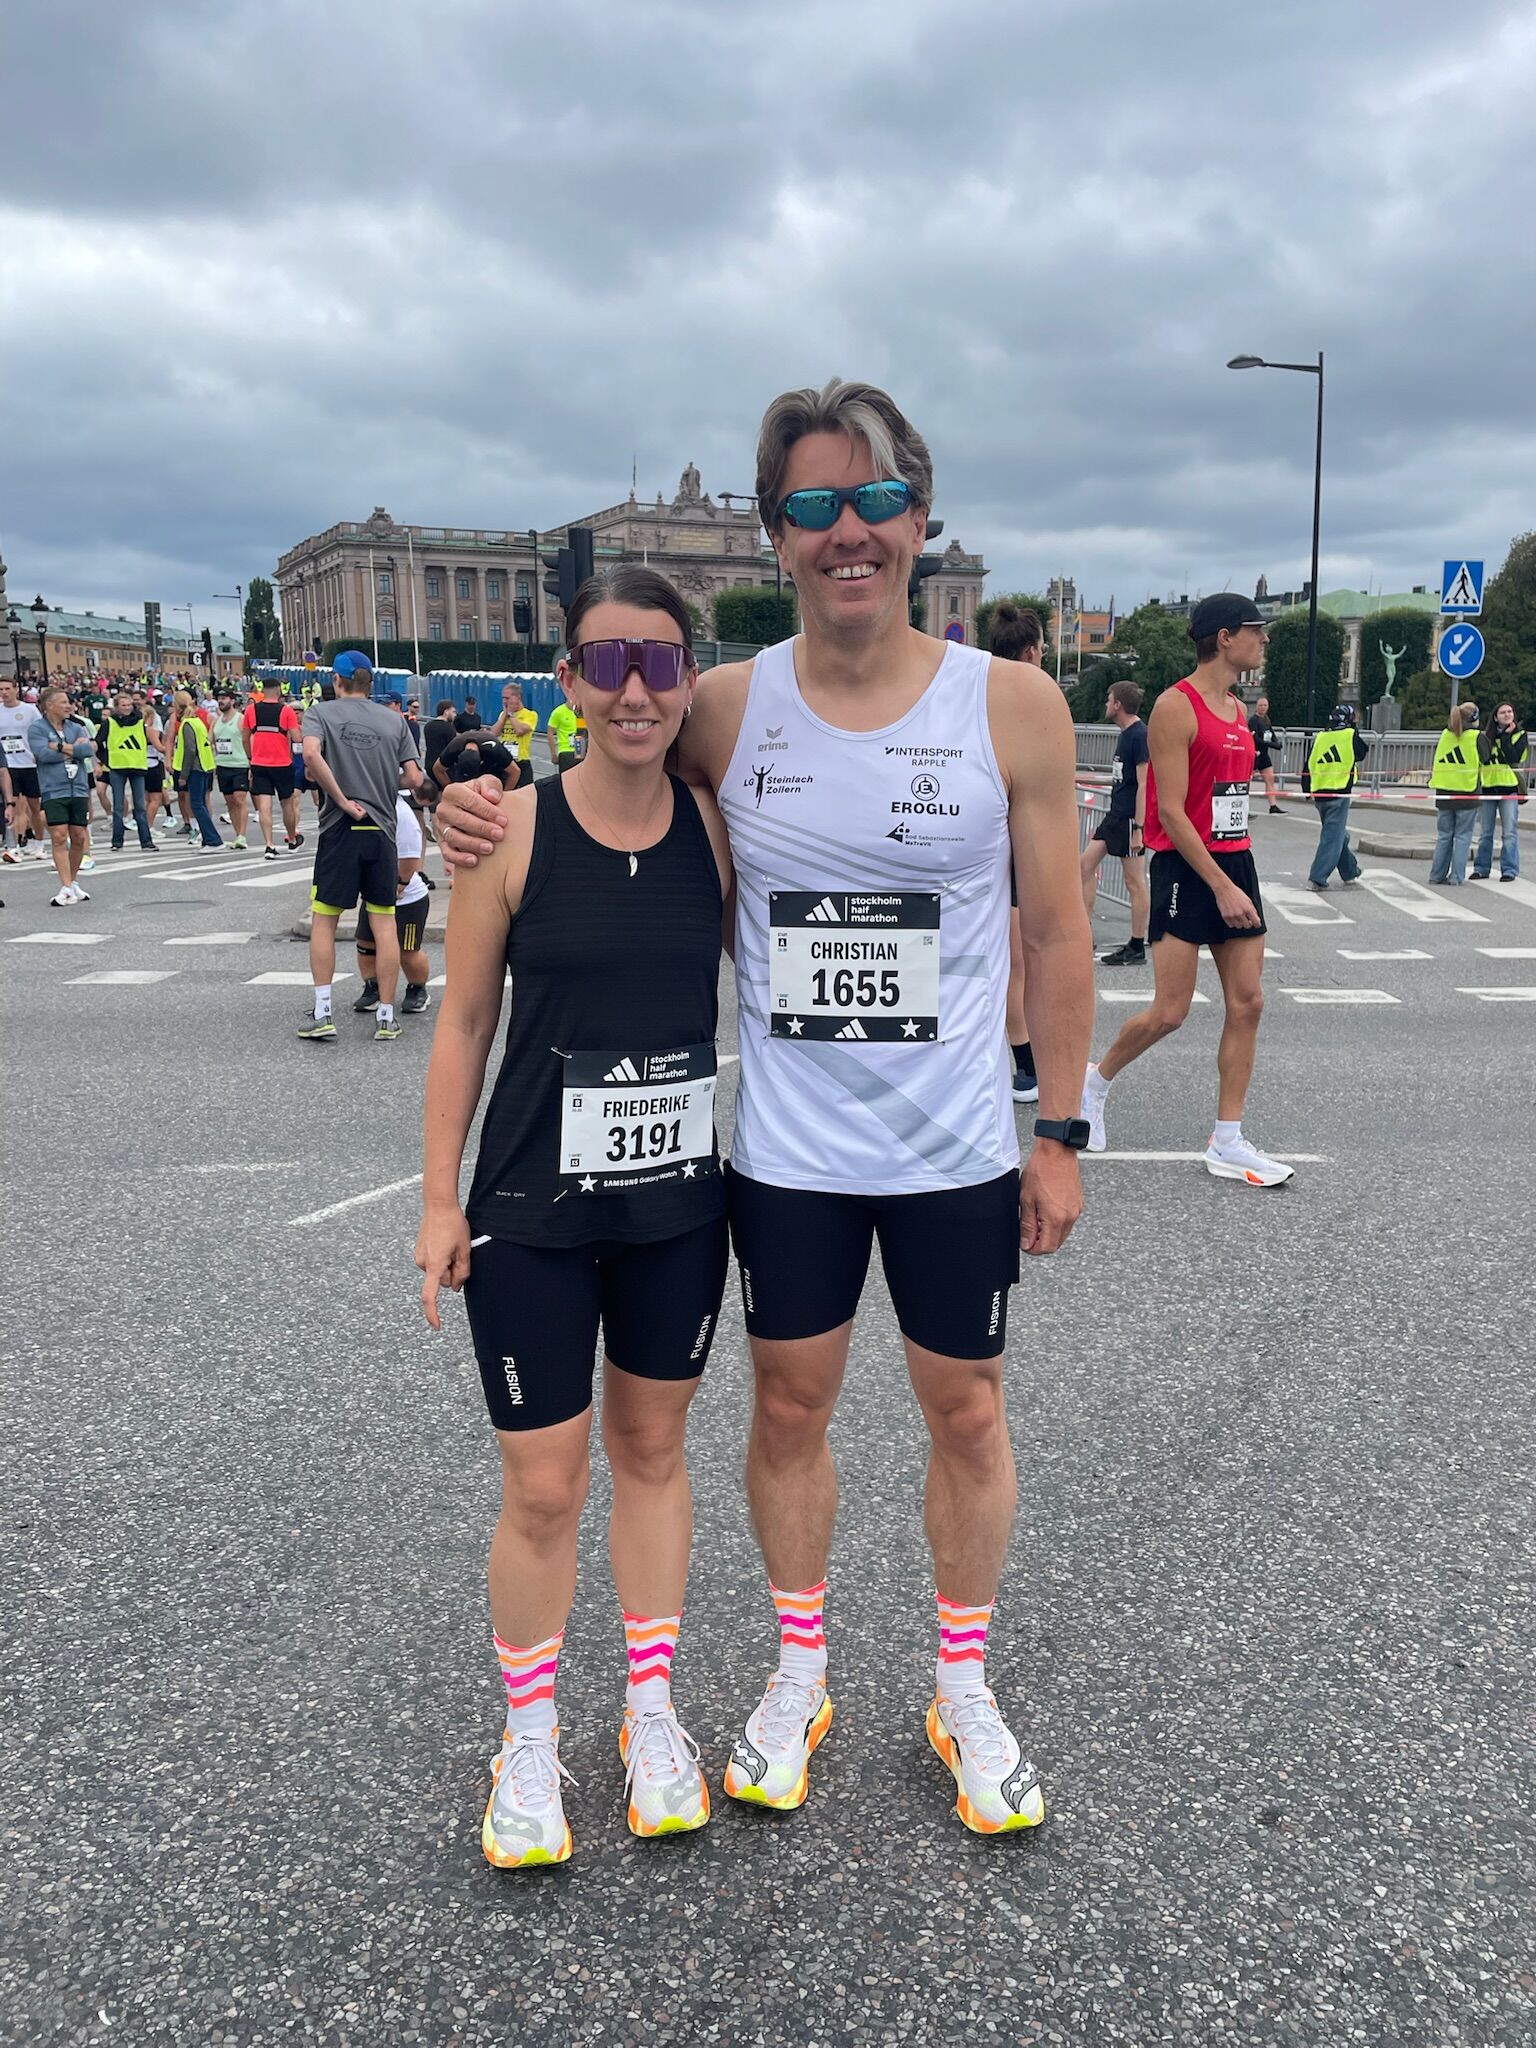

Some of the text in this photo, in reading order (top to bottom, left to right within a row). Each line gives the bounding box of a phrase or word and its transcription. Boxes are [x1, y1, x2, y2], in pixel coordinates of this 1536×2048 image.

[193, 652, 202, 665] G
[758, 741, 788, 752] erima
[895, 747, 964, 759] INTERSPORT
[911, 758, 947, 767] RÄPPLE
[744, 778, 754, 787] LG
[767, 776, 813, 785] Steinlach
[766, 786, 801, 794] Zollern
[891, 801, 960, 816] EROGLU
[851, 896, 902, 905] stockholm
[851, 905, 870, 914] half
[851, 913, 898, 922] marathon
[811, 941, 898, 960] CHRISTIAN
[812, 968, 900, 1007] 1655
[650, 1051, 690, 1064] stockholm
[650, 1063, 667, 1072] half
[649, 1069, 688, 1080] marathon
[603, 1094, 690, 1118] FRIEDERIKE
[606, 1119, 681, 1162] 3191
[603, 1170, 678, 1187] SAMSUNG Galaxy Watch
[743, 1268, 755, 1313] FUSION
[988, 1290, 1001, 1336] FUSION
[690, 1314, 711, 1359] FUSION
[502, 1356, 524, 1405] FUSION
